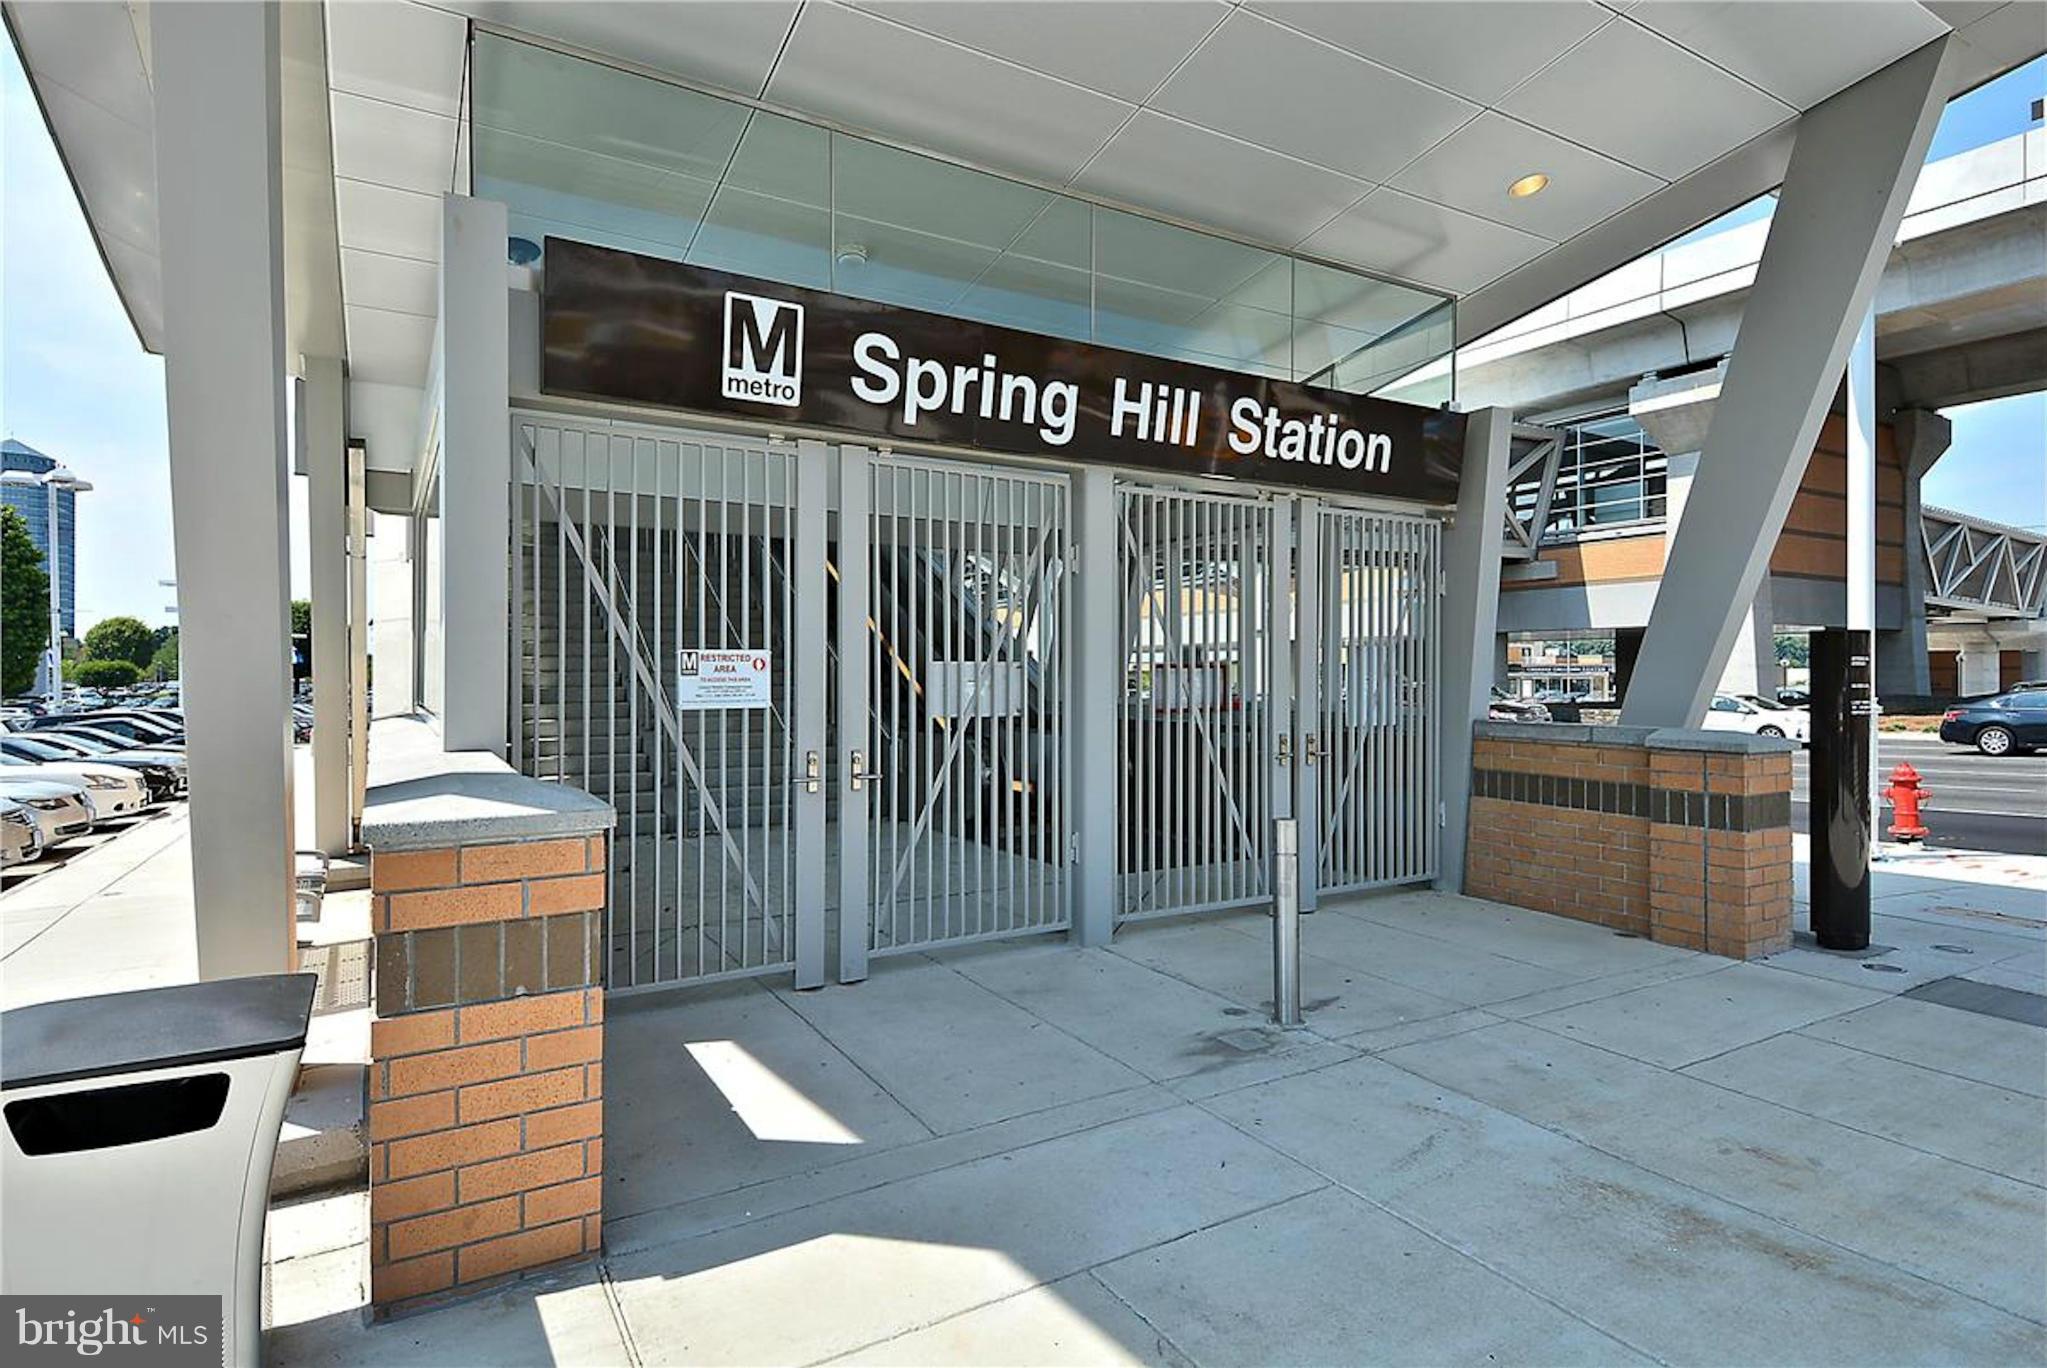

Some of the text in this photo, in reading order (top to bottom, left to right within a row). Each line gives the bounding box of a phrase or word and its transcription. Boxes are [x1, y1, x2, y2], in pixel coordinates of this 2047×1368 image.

[729, 297, 797, 378] M
[727, 376, 796, 401] metro
[850, 331, 1393, 473] Spring Hill Station
[701, 654, 751, 662] RESTRICTED
[713, 665, 736, 673] AREA
